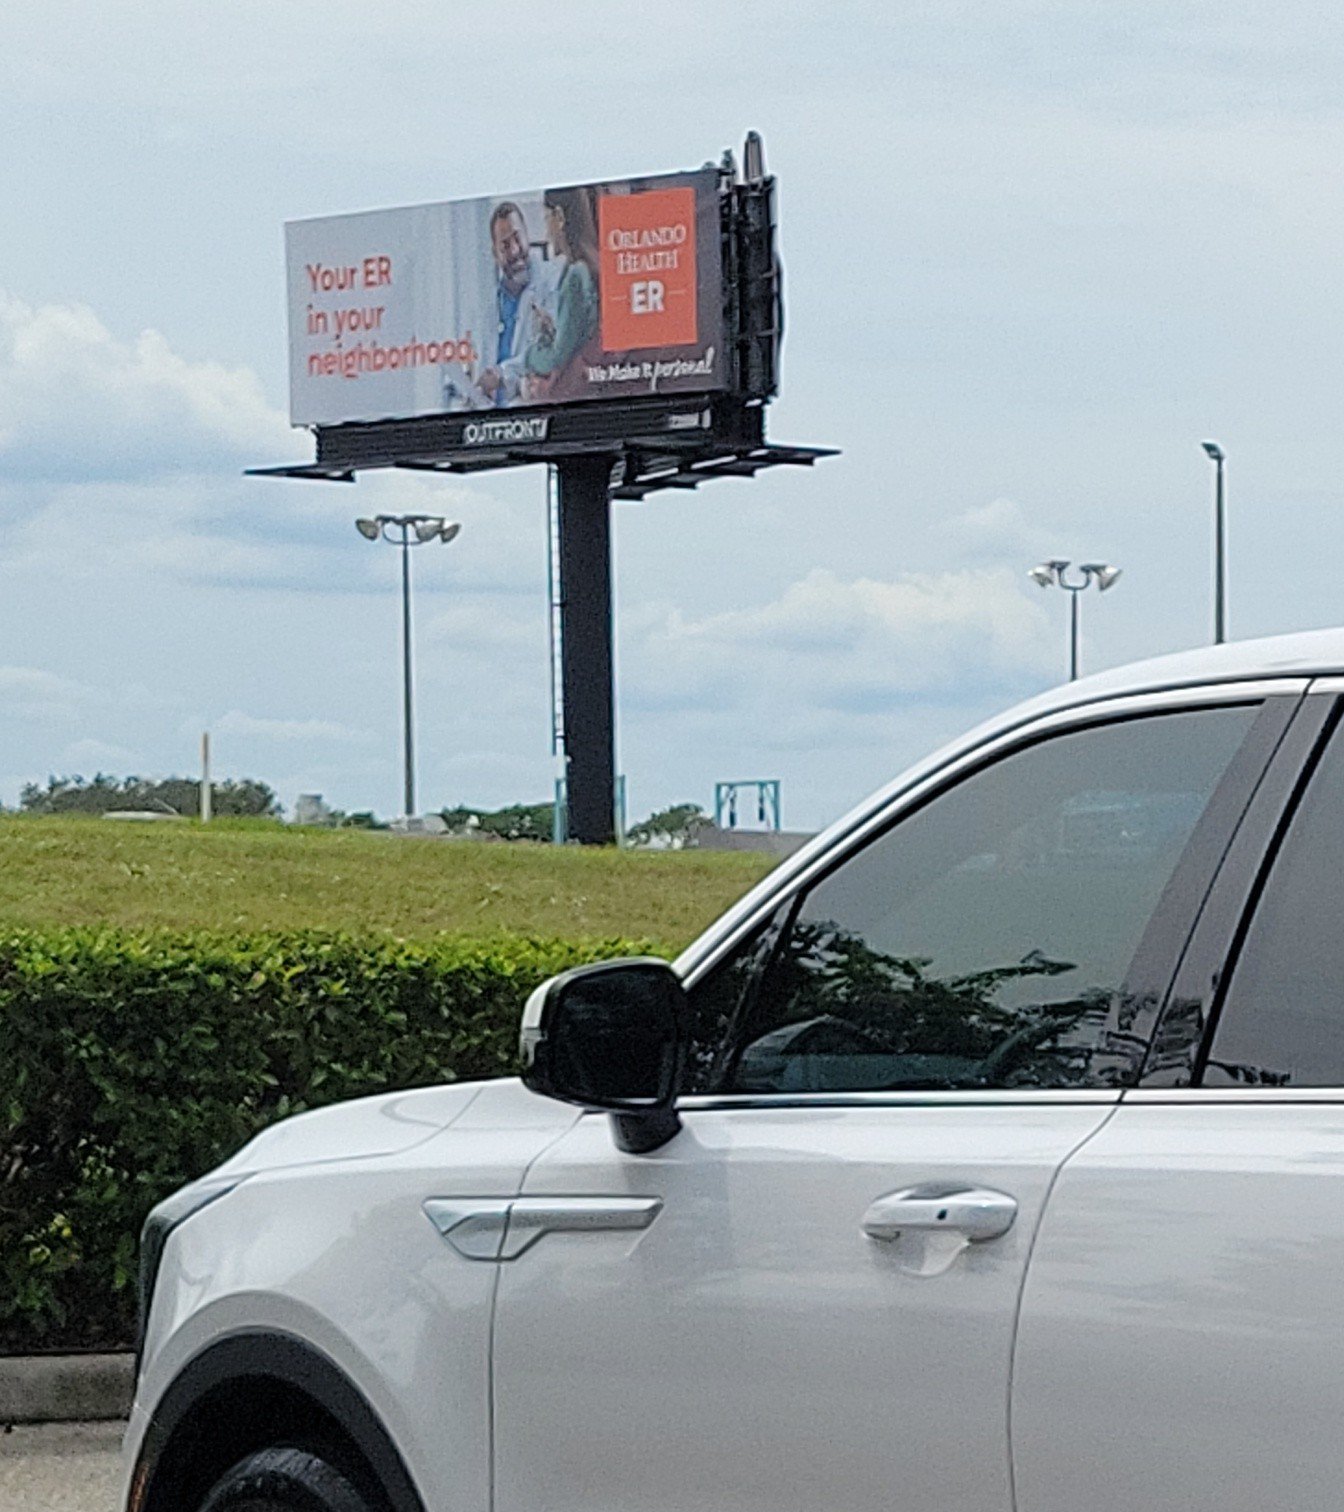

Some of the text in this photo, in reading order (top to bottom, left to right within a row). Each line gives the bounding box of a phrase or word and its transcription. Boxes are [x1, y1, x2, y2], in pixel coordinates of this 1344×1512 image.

[607, 223, 687, 251] ORLANDO
[306, 256, 392, 293] Your ER
[617, 249, 679, 275] HEALTH
[631, 280, 665, 314] ER
[307, 304, 385, 340] in your
[307, 330, 479, 379] neighborhood.
